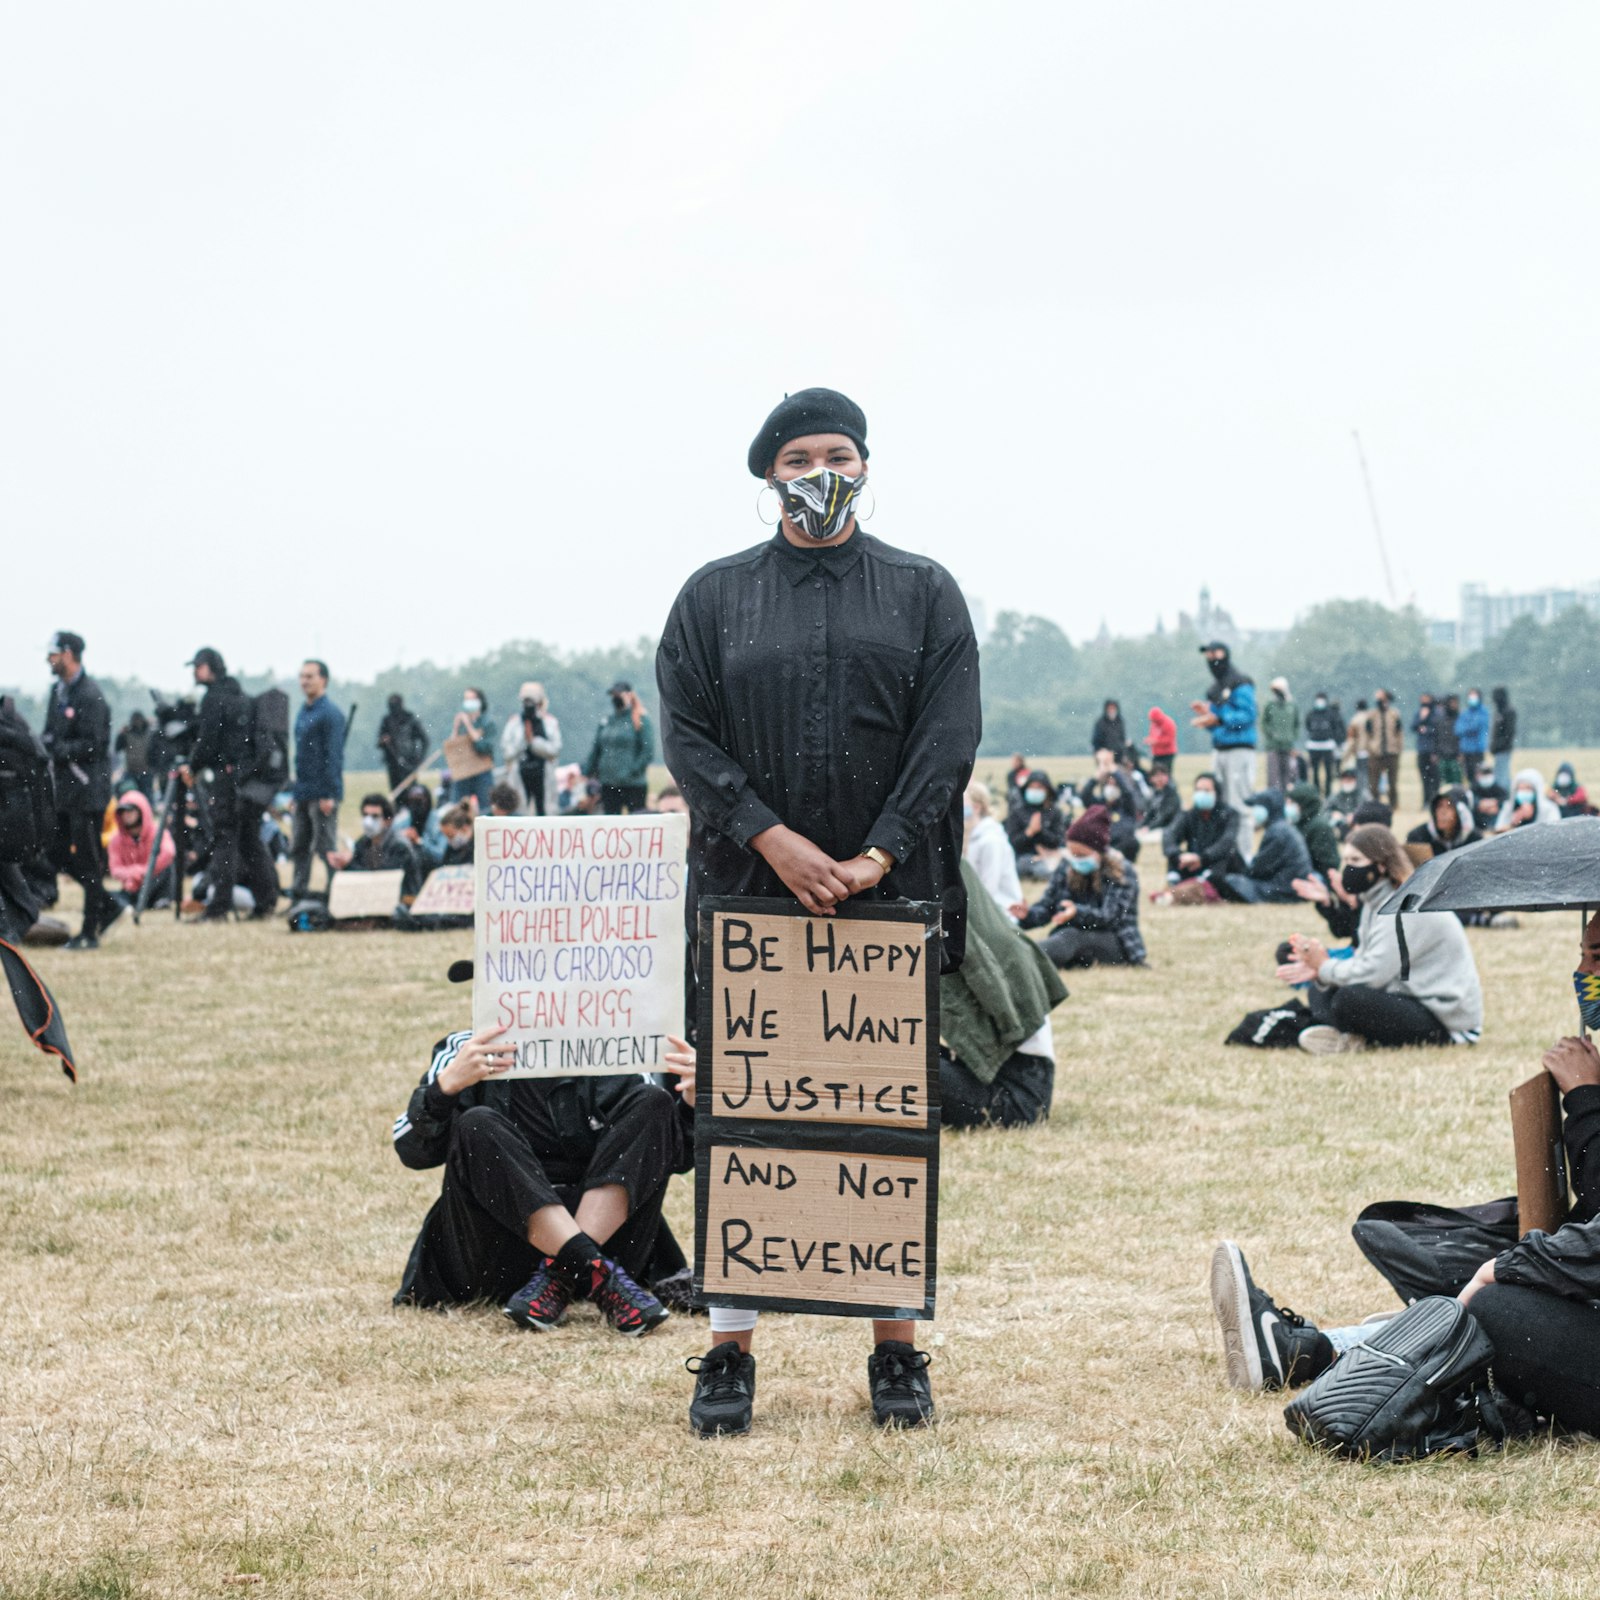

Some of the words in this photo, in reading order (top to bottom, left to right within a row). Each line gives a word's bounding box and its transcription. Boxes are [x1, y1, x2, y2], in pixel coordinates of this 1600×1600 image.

[485, 829, 555, 860] EDSON
[560, 828, 586, 859] DA
[591, 826, 664, 859] COSTA
[486, 863, 582, 902] RASHAN
[584, 861, 680, 902] CHARLES
[485, 908, 577, 944] MICHAEL
[580, 905, 658, 943] POWELL
[485, 948, 546, 984] NUNO
[554, 945, 654, 981] CARDOSO
[722, 919, 784, 973] BE
[806, 920, 922, 977] HAPPY
[497, 990, 567, 1029] SEAN
[577, 988, 633, 1028] RIGG
[724, 987, 779, 1040] WE
[822, 989, 923, 1045] WANT
[512, 1039, 554, 1070] NOT
[559, 1034, 667, 1068] INNOCENT
[722, 1051, 919, 1117] JUSTICE
[723, 1152, 798, 1190] AND
[838, 1162, 919, 1200] NOT
[721, 1218, 921, 1278] REVENGE
